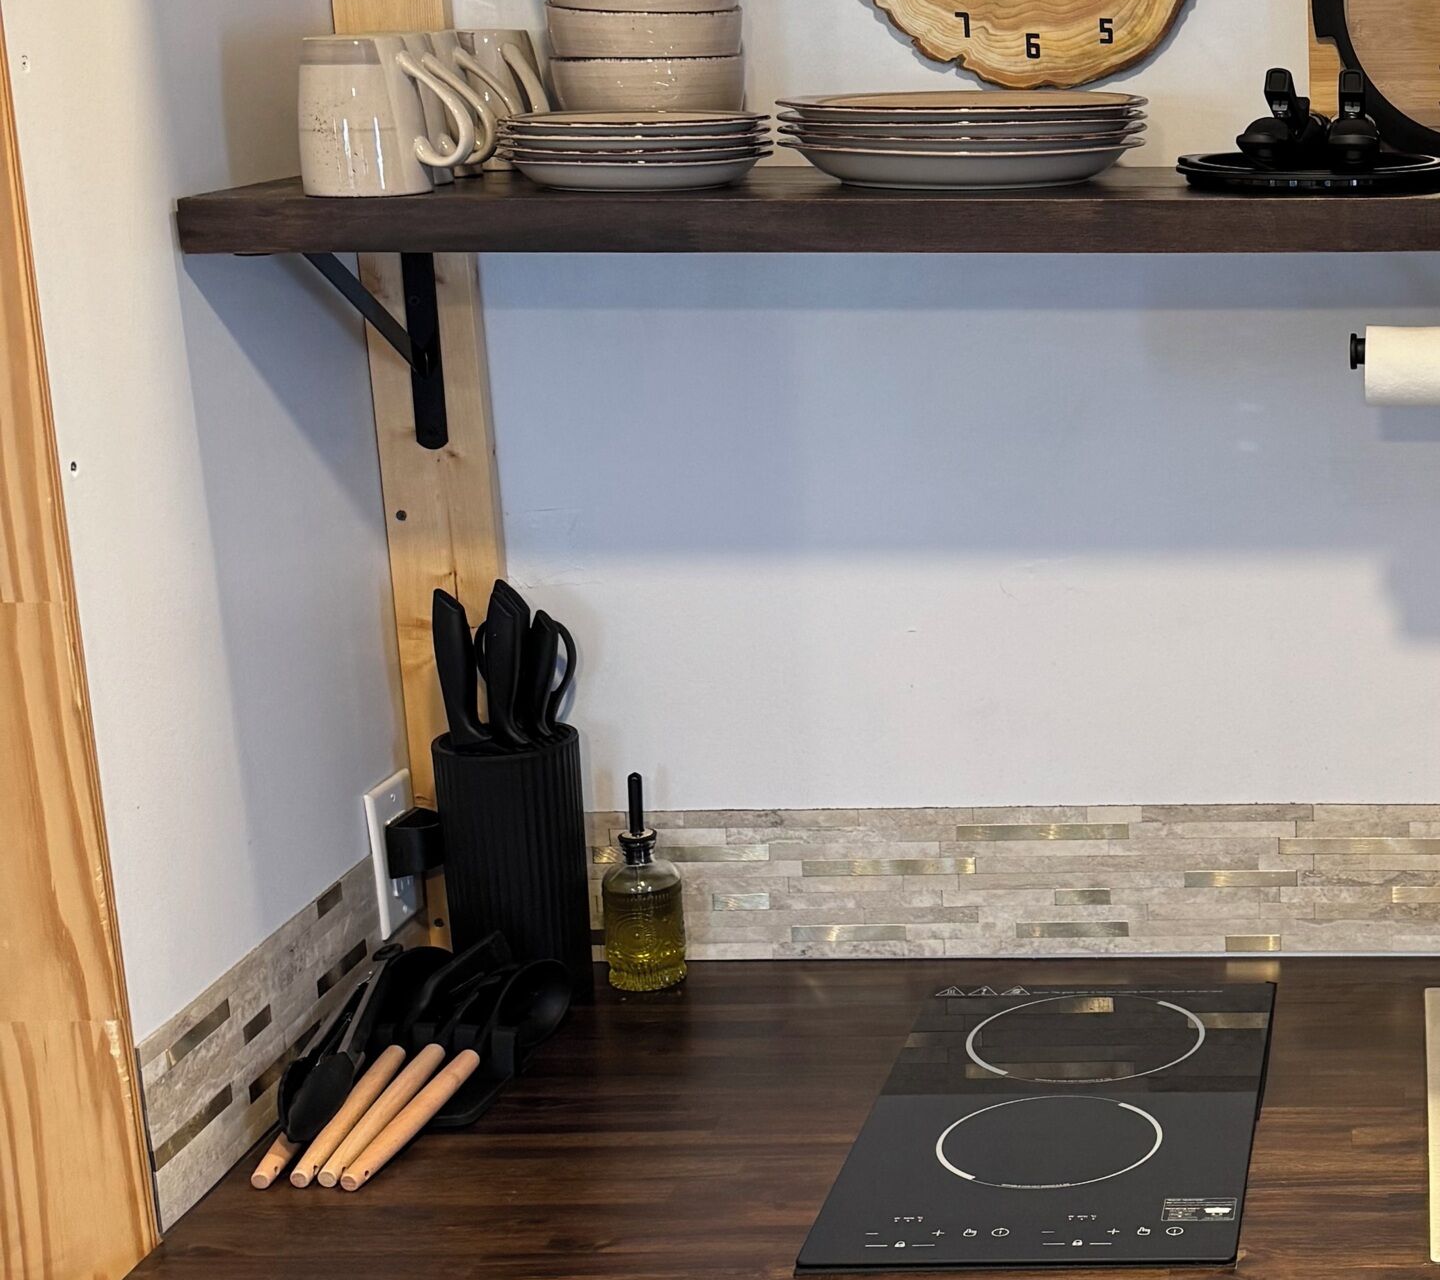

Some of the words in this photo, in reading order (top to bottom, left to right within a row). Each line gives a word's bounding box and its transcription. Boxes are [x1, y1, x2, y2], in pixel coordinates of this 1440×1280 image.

[954, 11, 971, 38] 7
[1099, 17, 1114, 45] 5
[1025, 32, 1041, 59] 6
